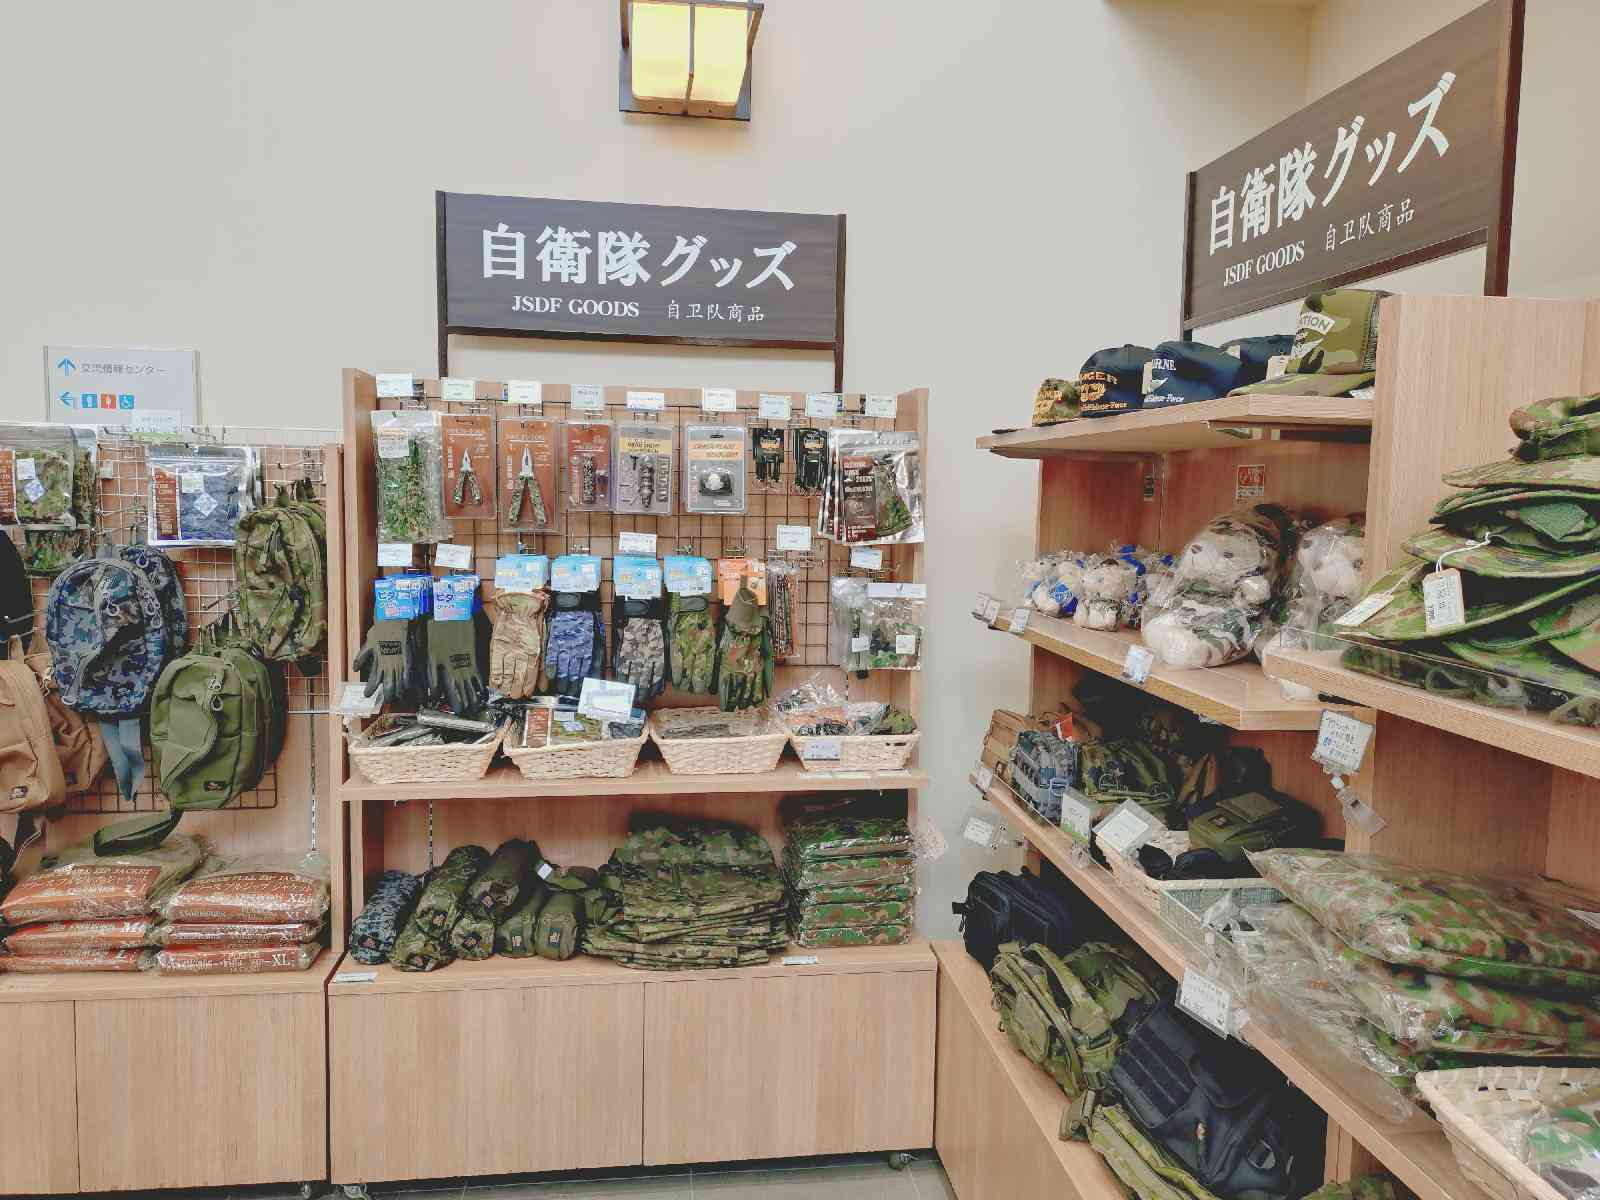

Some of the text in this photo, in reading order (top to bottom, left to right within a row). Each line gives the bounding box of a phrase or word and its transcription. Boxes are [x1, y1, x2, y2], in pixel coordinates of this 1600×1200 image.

[1209, 71, 1456, 256] 自衛隊グッズ
[1324, 198, 1417, 252] 自卫队商品
[481, 222, 798, 291] 自衛隊グッズ
[1223, 240, 1305, 287] JSDF GOODS
[511, 295, 640, 318] JSDF GOODS
[667, 300, 765, 322] 自卫队商品
